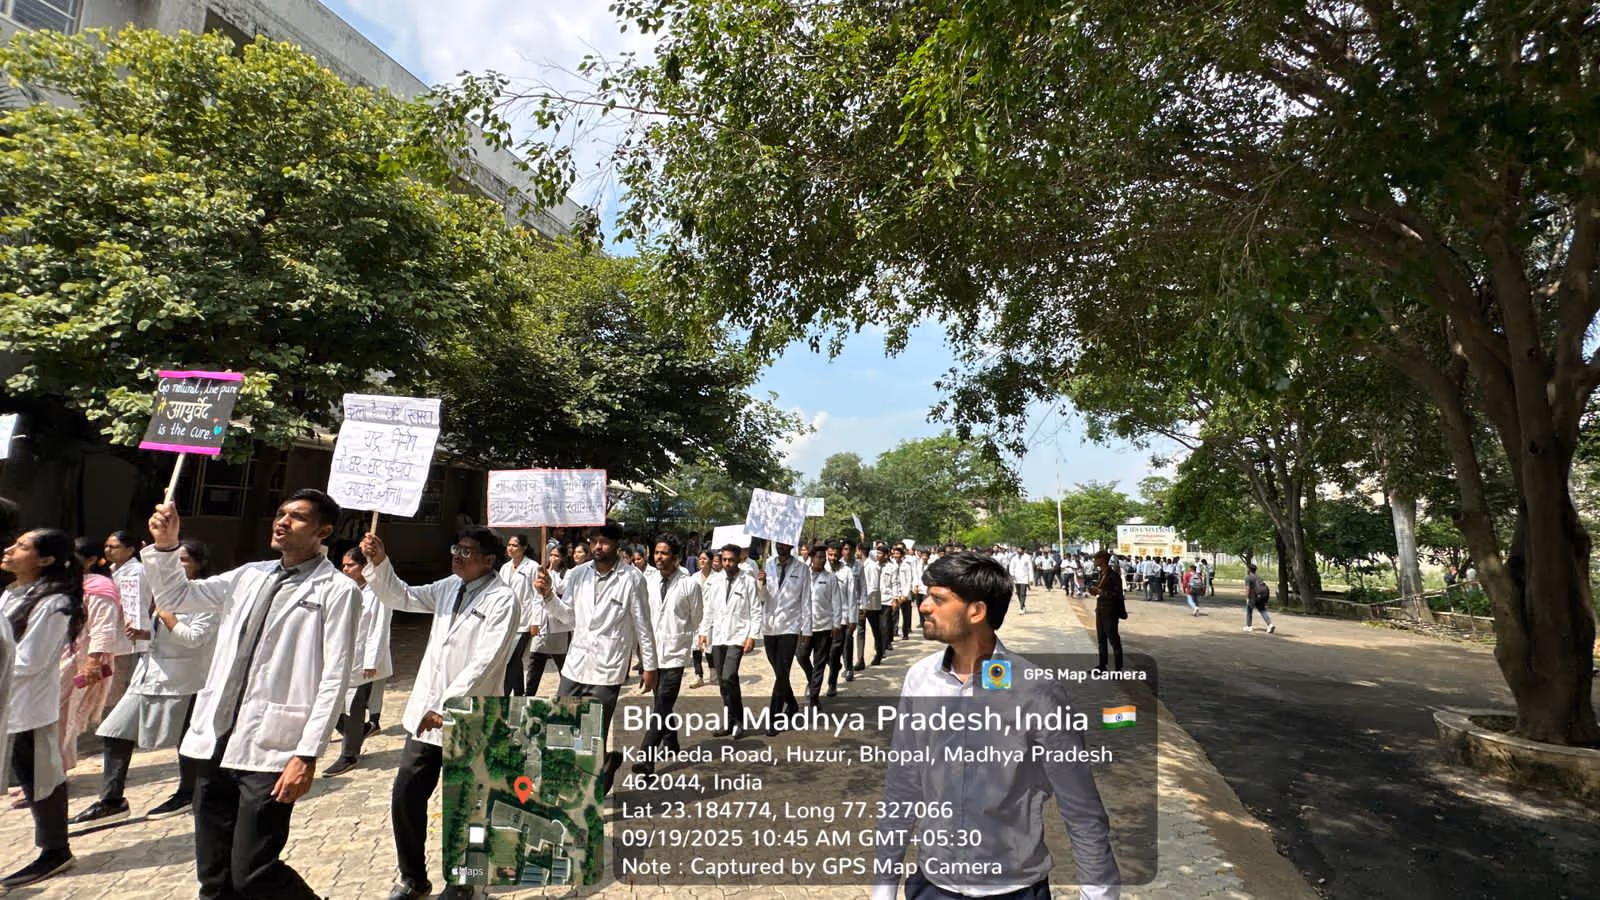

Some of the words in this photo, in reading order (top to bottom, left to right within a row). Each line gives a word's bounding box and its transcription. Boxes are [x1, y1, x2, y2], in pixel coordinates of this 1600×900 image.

[158, 378, 170, 395] Go
[217, 384, 238, 401] pure
[167, 396, 213, 422] आयुर्वेद
[158, 423, 167, 436] is
[171, 423, 187, 437] the
[190, 426, 212, 440] cure.
